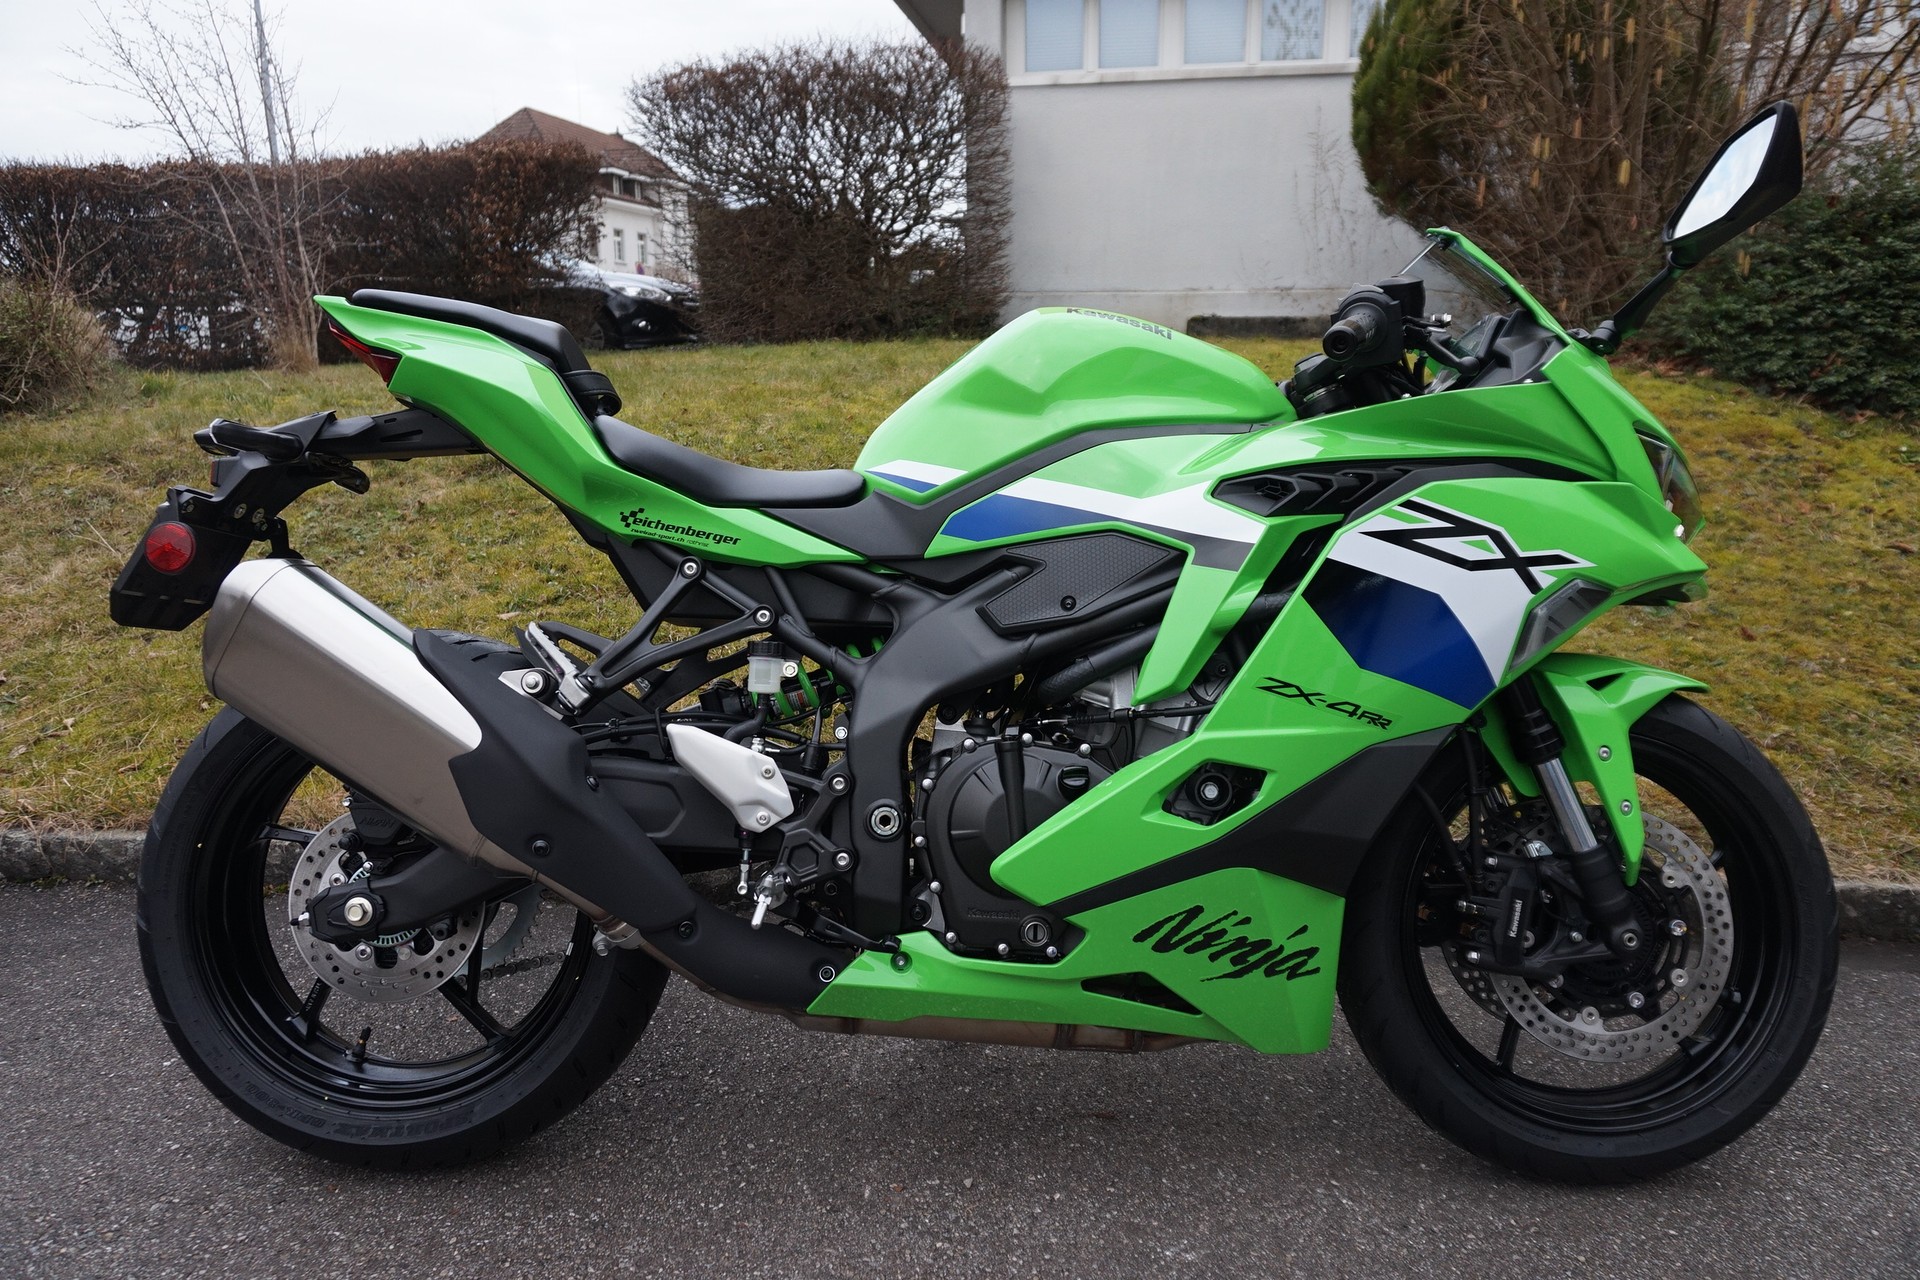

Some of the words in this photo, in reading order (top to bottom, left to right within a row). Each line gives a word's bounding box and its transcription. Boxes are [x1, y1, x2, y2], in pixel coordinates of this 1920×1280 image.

[1066, 307, 1173, 341] Kawasaki
[632, 516, 742, 545] eichenberger
[1255, 677, 1393, 731] ZX-4RR
[967, 907, 1021, 920] Kawasaki
[1509, 899, 1523, 938] Kawasaki
[1132, 904, 1321, 982] Ninja
